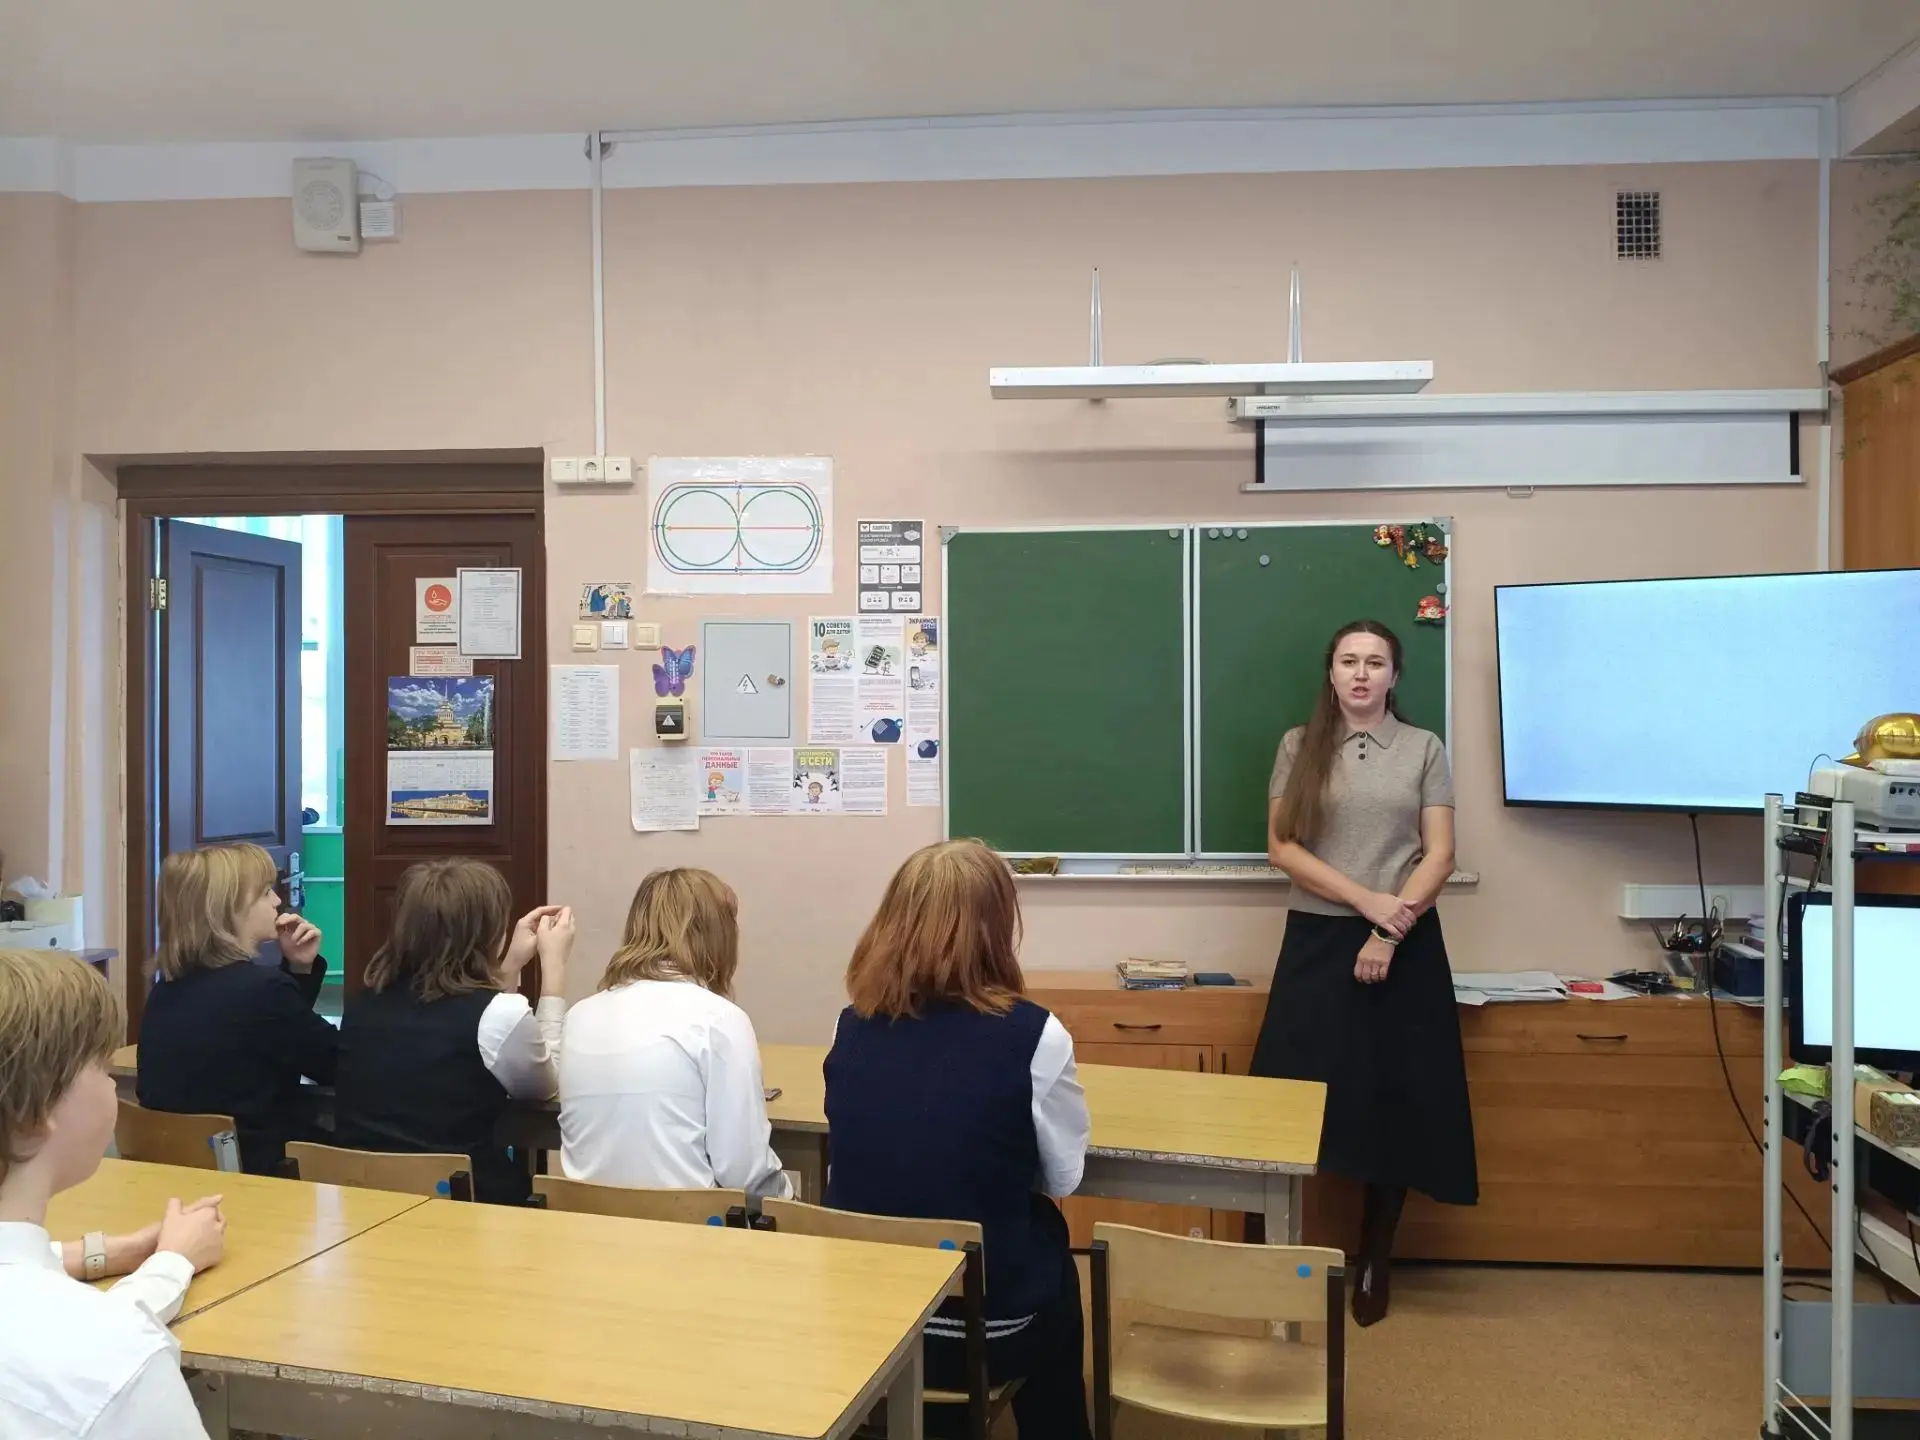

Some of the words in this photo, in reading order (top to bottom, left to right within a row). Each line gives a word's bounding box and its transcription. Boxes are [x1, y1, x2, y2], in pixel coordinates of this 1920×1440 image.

[814, 622, 825, 637] 10
[705, 761, 738, 769] ДАННЫЕ
[800, 757, 806, 766] В
[809, 757, 832, 766] СЕТИ
